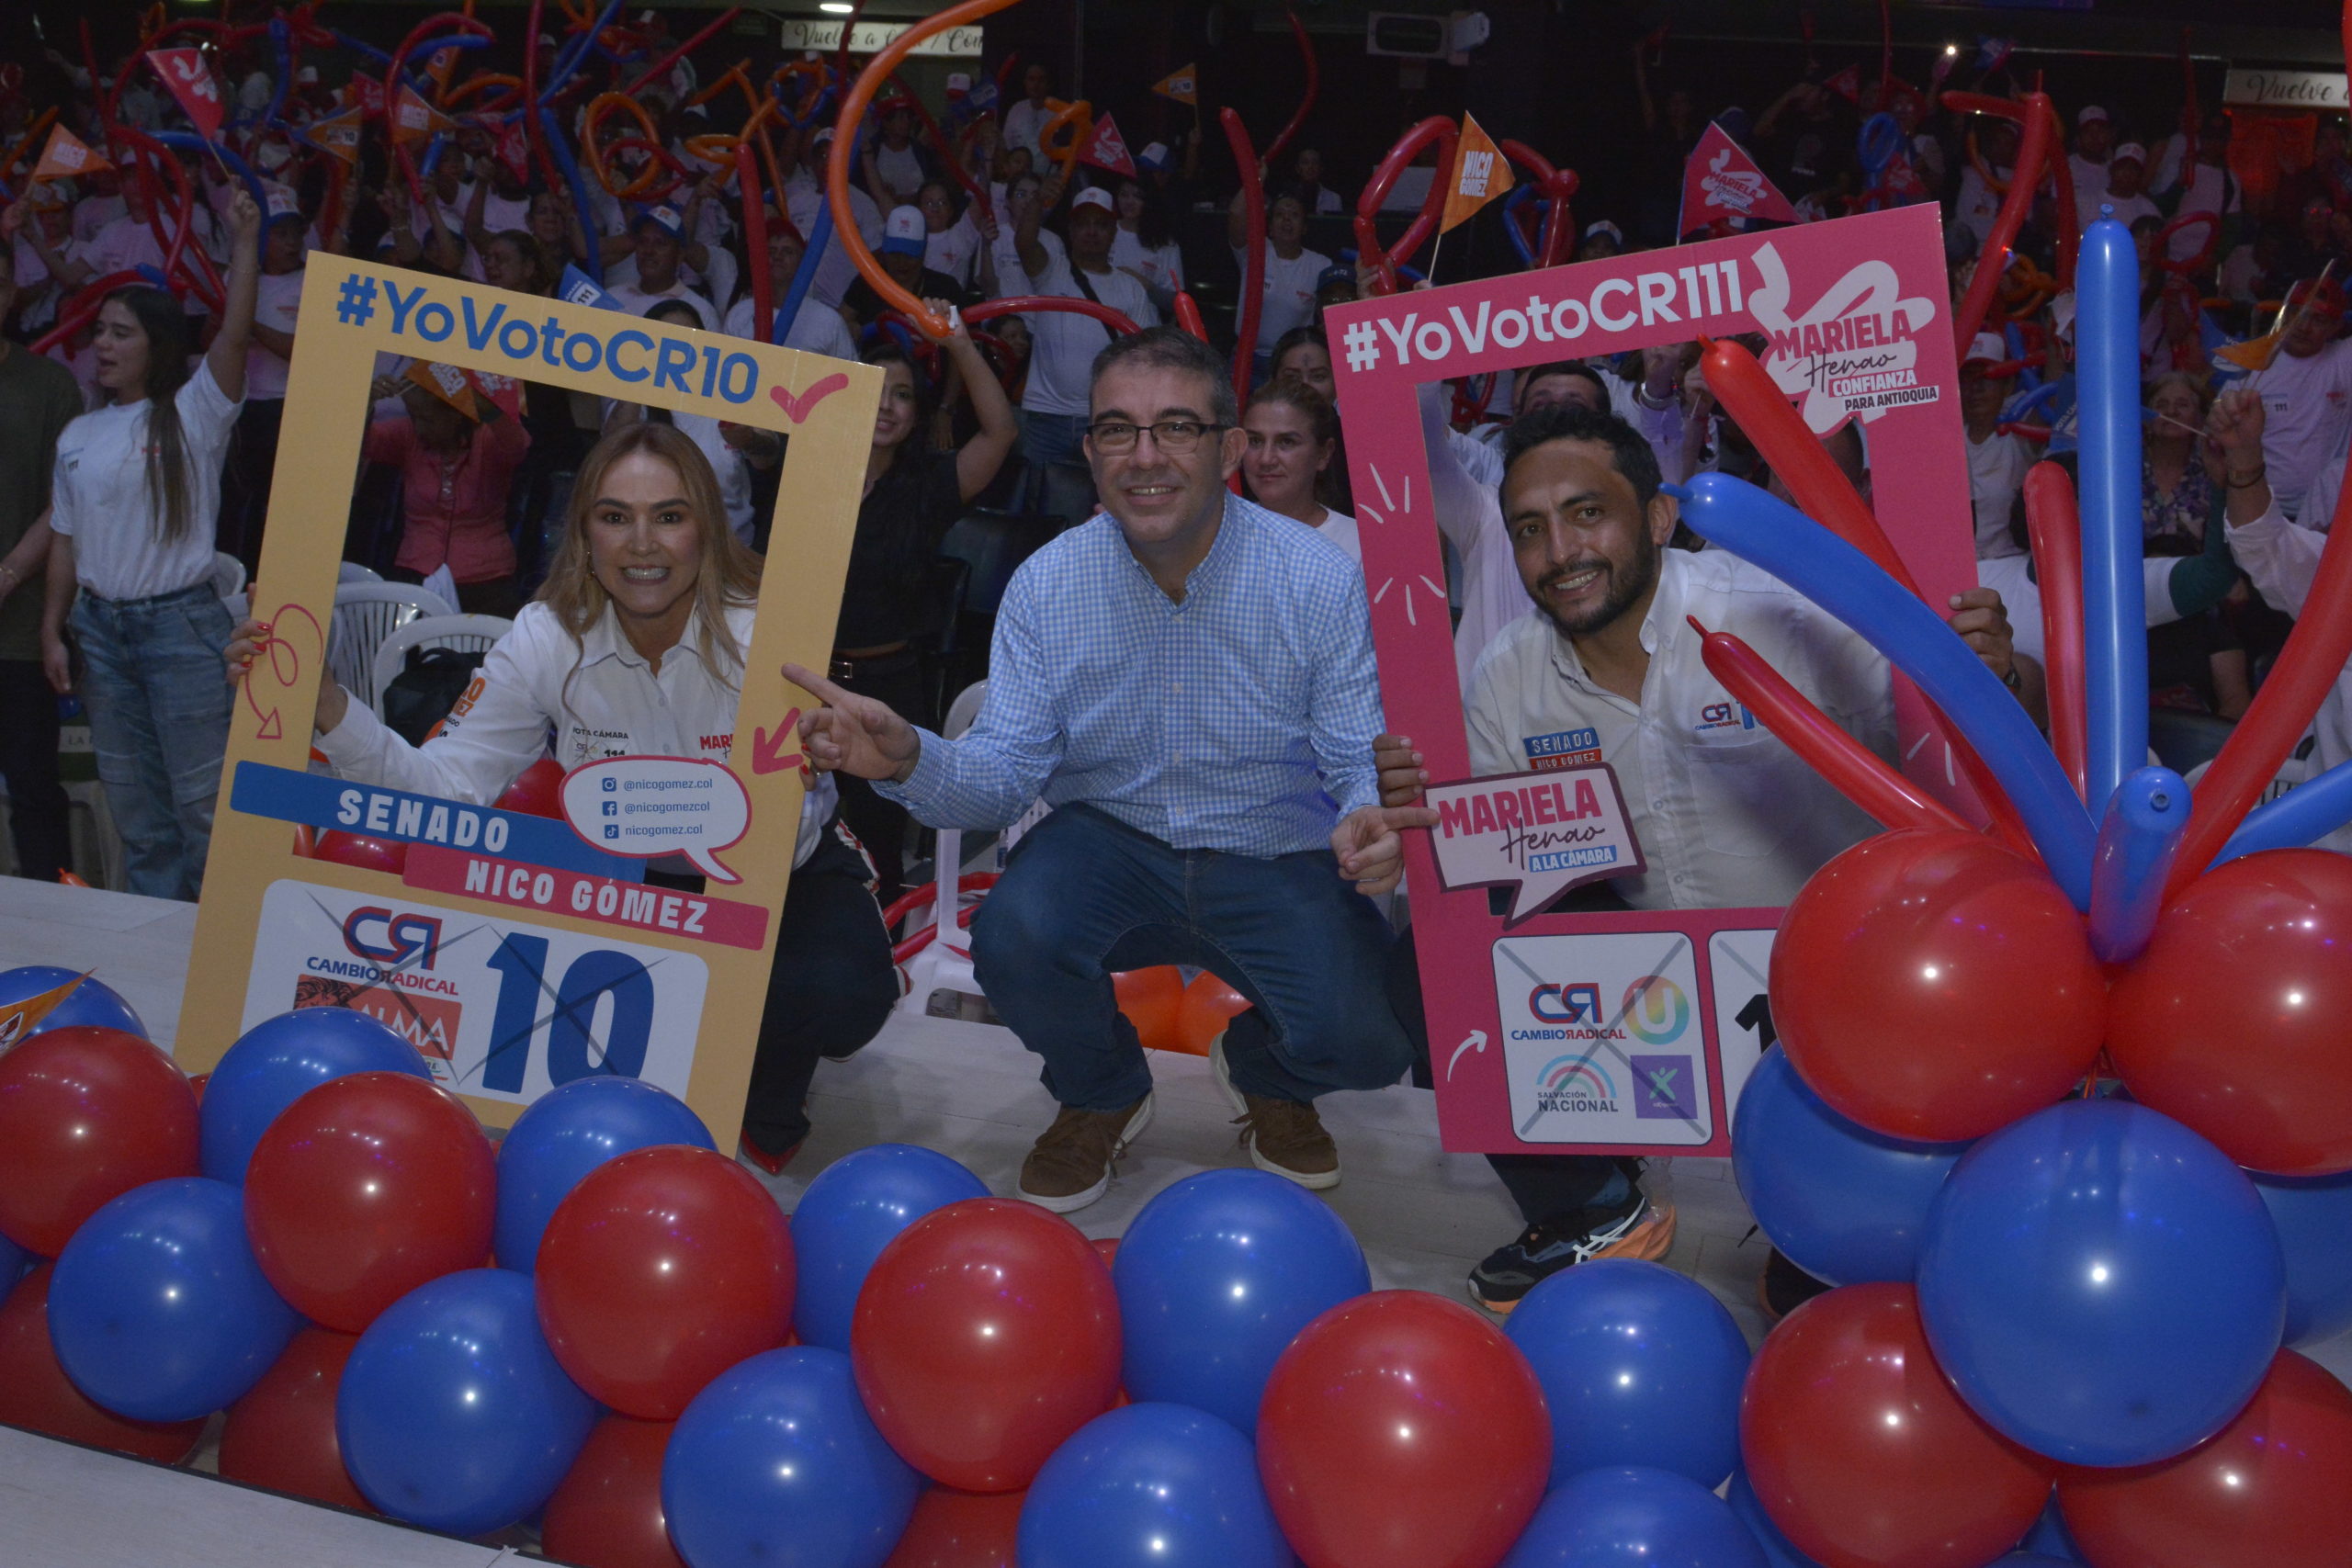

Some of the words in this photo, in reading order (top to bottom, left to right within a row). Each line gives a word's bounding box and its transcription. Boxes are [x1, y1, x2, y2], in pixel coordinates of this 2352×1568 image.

[795, 24, 854, 45] Vuele
[2247, 73, 2333, 102] Vuelve
[578, 288, 594, 303] 111
[1342, 259, 1744, 373] #YoVotoCR111
[336, 274, 759, 404] #YoVotoCR10
[1774, 309, 1915, 362] MARIELA
[1804, 348, 1897, 393] Henao
[1832, 369, 1917, 397] CONFIANZA
[1844, 396, 1874, 411] PARA
[1877, 387, 1938, 407] ANTIOQUIA
[1532, 731, 1592, 753] SENADO
[624, 778, 713, 792] @nicogomez.col
[337, 788, 510, 852] SENADO
[624, 801, 710, 815] @nicogomezcol
[1437, 778, 1602, 839] MARIELA
[625, 824, 703, 837] nicogomez.col
[1499, 817, 1606, 871] Henao
[1532, 856, 1543, 871] A
[1544, 853, 1560, 869] LA
[465, 859, 555, 905] NICO
[571, 878, 708, 934] GÓMEZ
[481, 931, 654, 1094] 10
[1537, 1090, 1587, 1099] SALVACIÓN
[1538, 1100, 1619, 1112] NACIONAL
